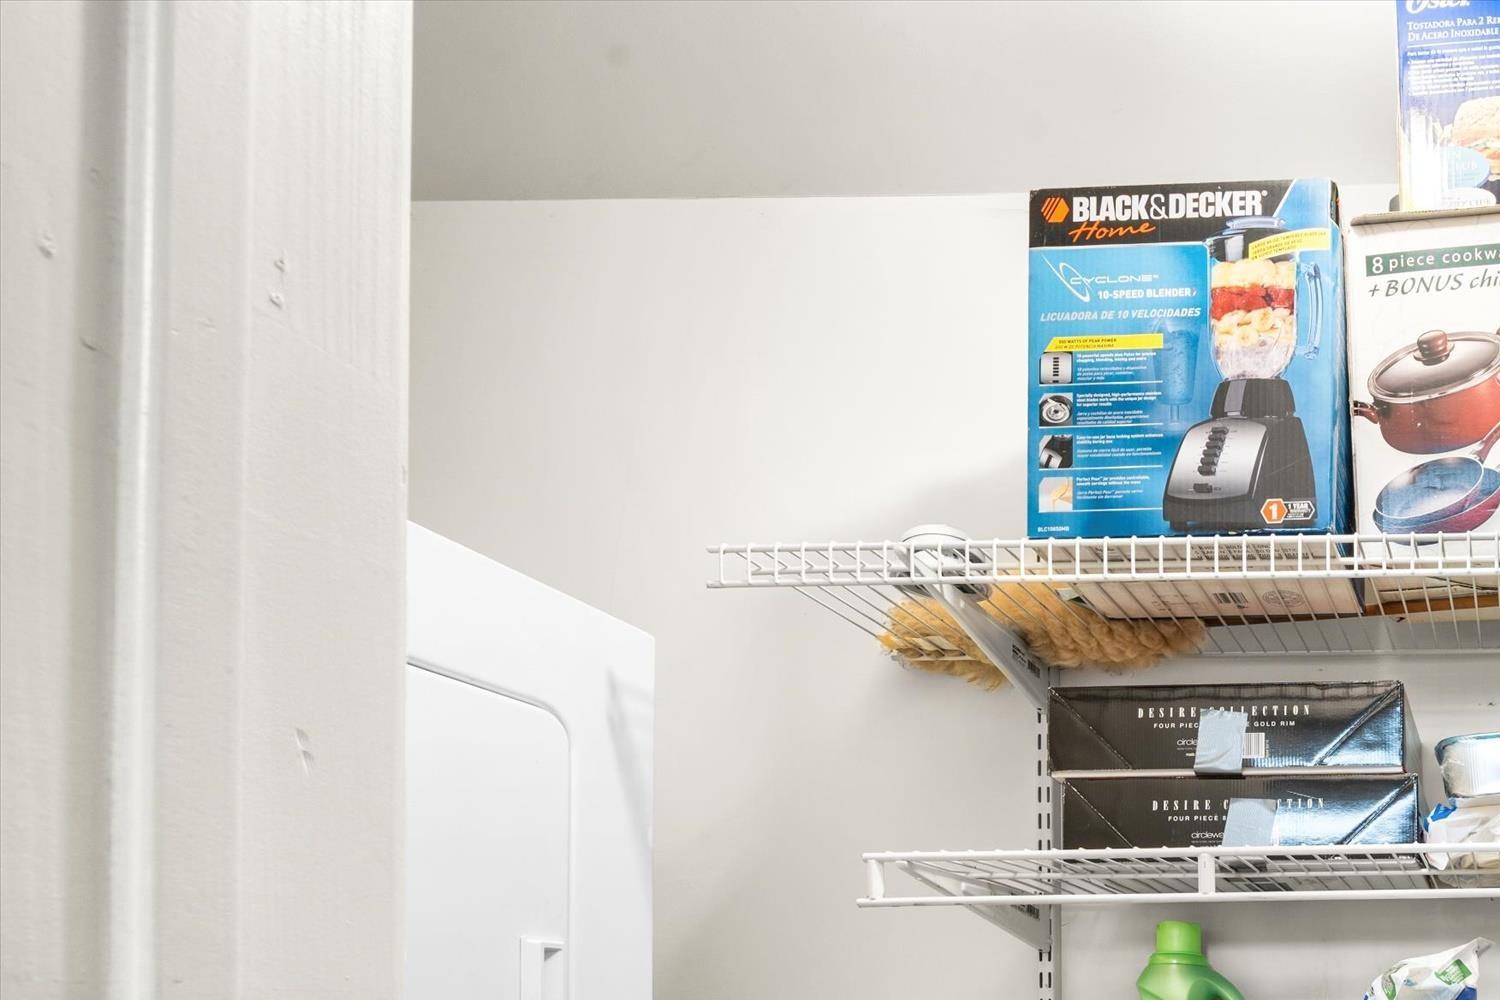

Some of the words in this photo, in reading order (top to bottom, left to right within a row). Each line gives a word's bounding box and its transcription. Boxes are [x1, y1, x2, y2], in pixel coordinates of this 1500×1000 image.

[1479, 16, 1485, 25] 2
[1068, 220, 1157, 244] Home
[1371, 256, 1384, 274] 8
[1388, 254, 1435, 272] piece
[1368, 284, 1380, 297] +
[1385, 273, 1464, 297] BONUS
[1098, 288, 1145, 301] 10-SPEED
[1145, 286, 1191, 299] BLENDER
[1040, 310, 1098, 322] LICUADORA
[1099, 310, 1114, 320] DE
[1116, 308, 1129, 319] 10
[1130, 307, 1201, 319] VELOCIDADES
[1137, 706, 1198, 719] DESIRE
[1280, 719, 1296, 727] RIM
[1152, 799, 1211, 811] DESIRE
[1193, 814, 1219, 822] PIECE
